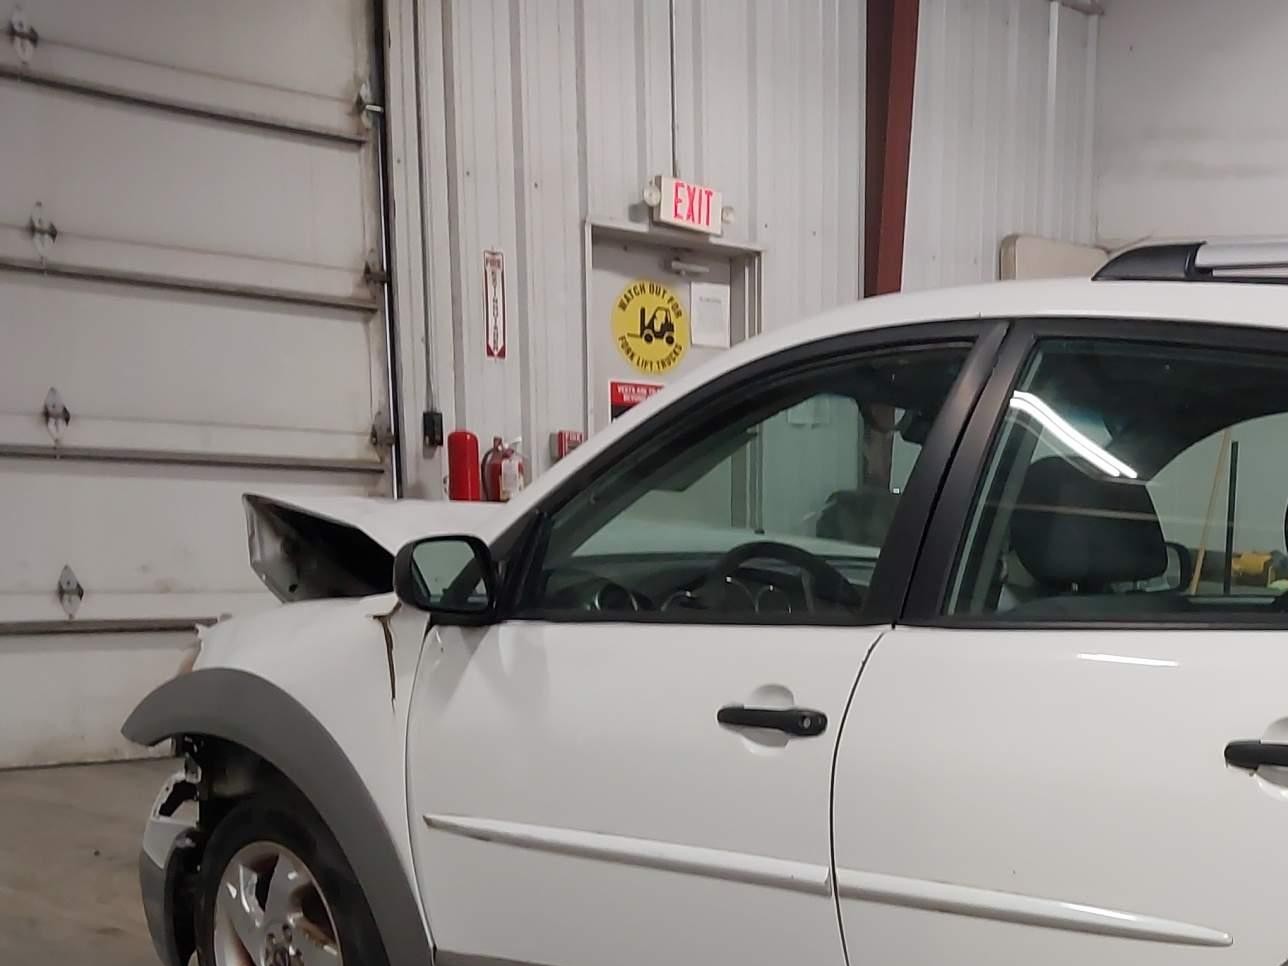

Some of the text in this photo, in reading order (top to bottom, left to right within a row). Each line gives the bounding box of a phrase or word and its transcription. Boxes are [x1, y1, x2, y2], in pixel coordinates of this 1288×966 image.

[673, 180, 714, 227] EXIT
[617, 281, 683, 319] WATCH OUT FOR
[618, 335, 683, 371] FORK LIFT TRUCKS
